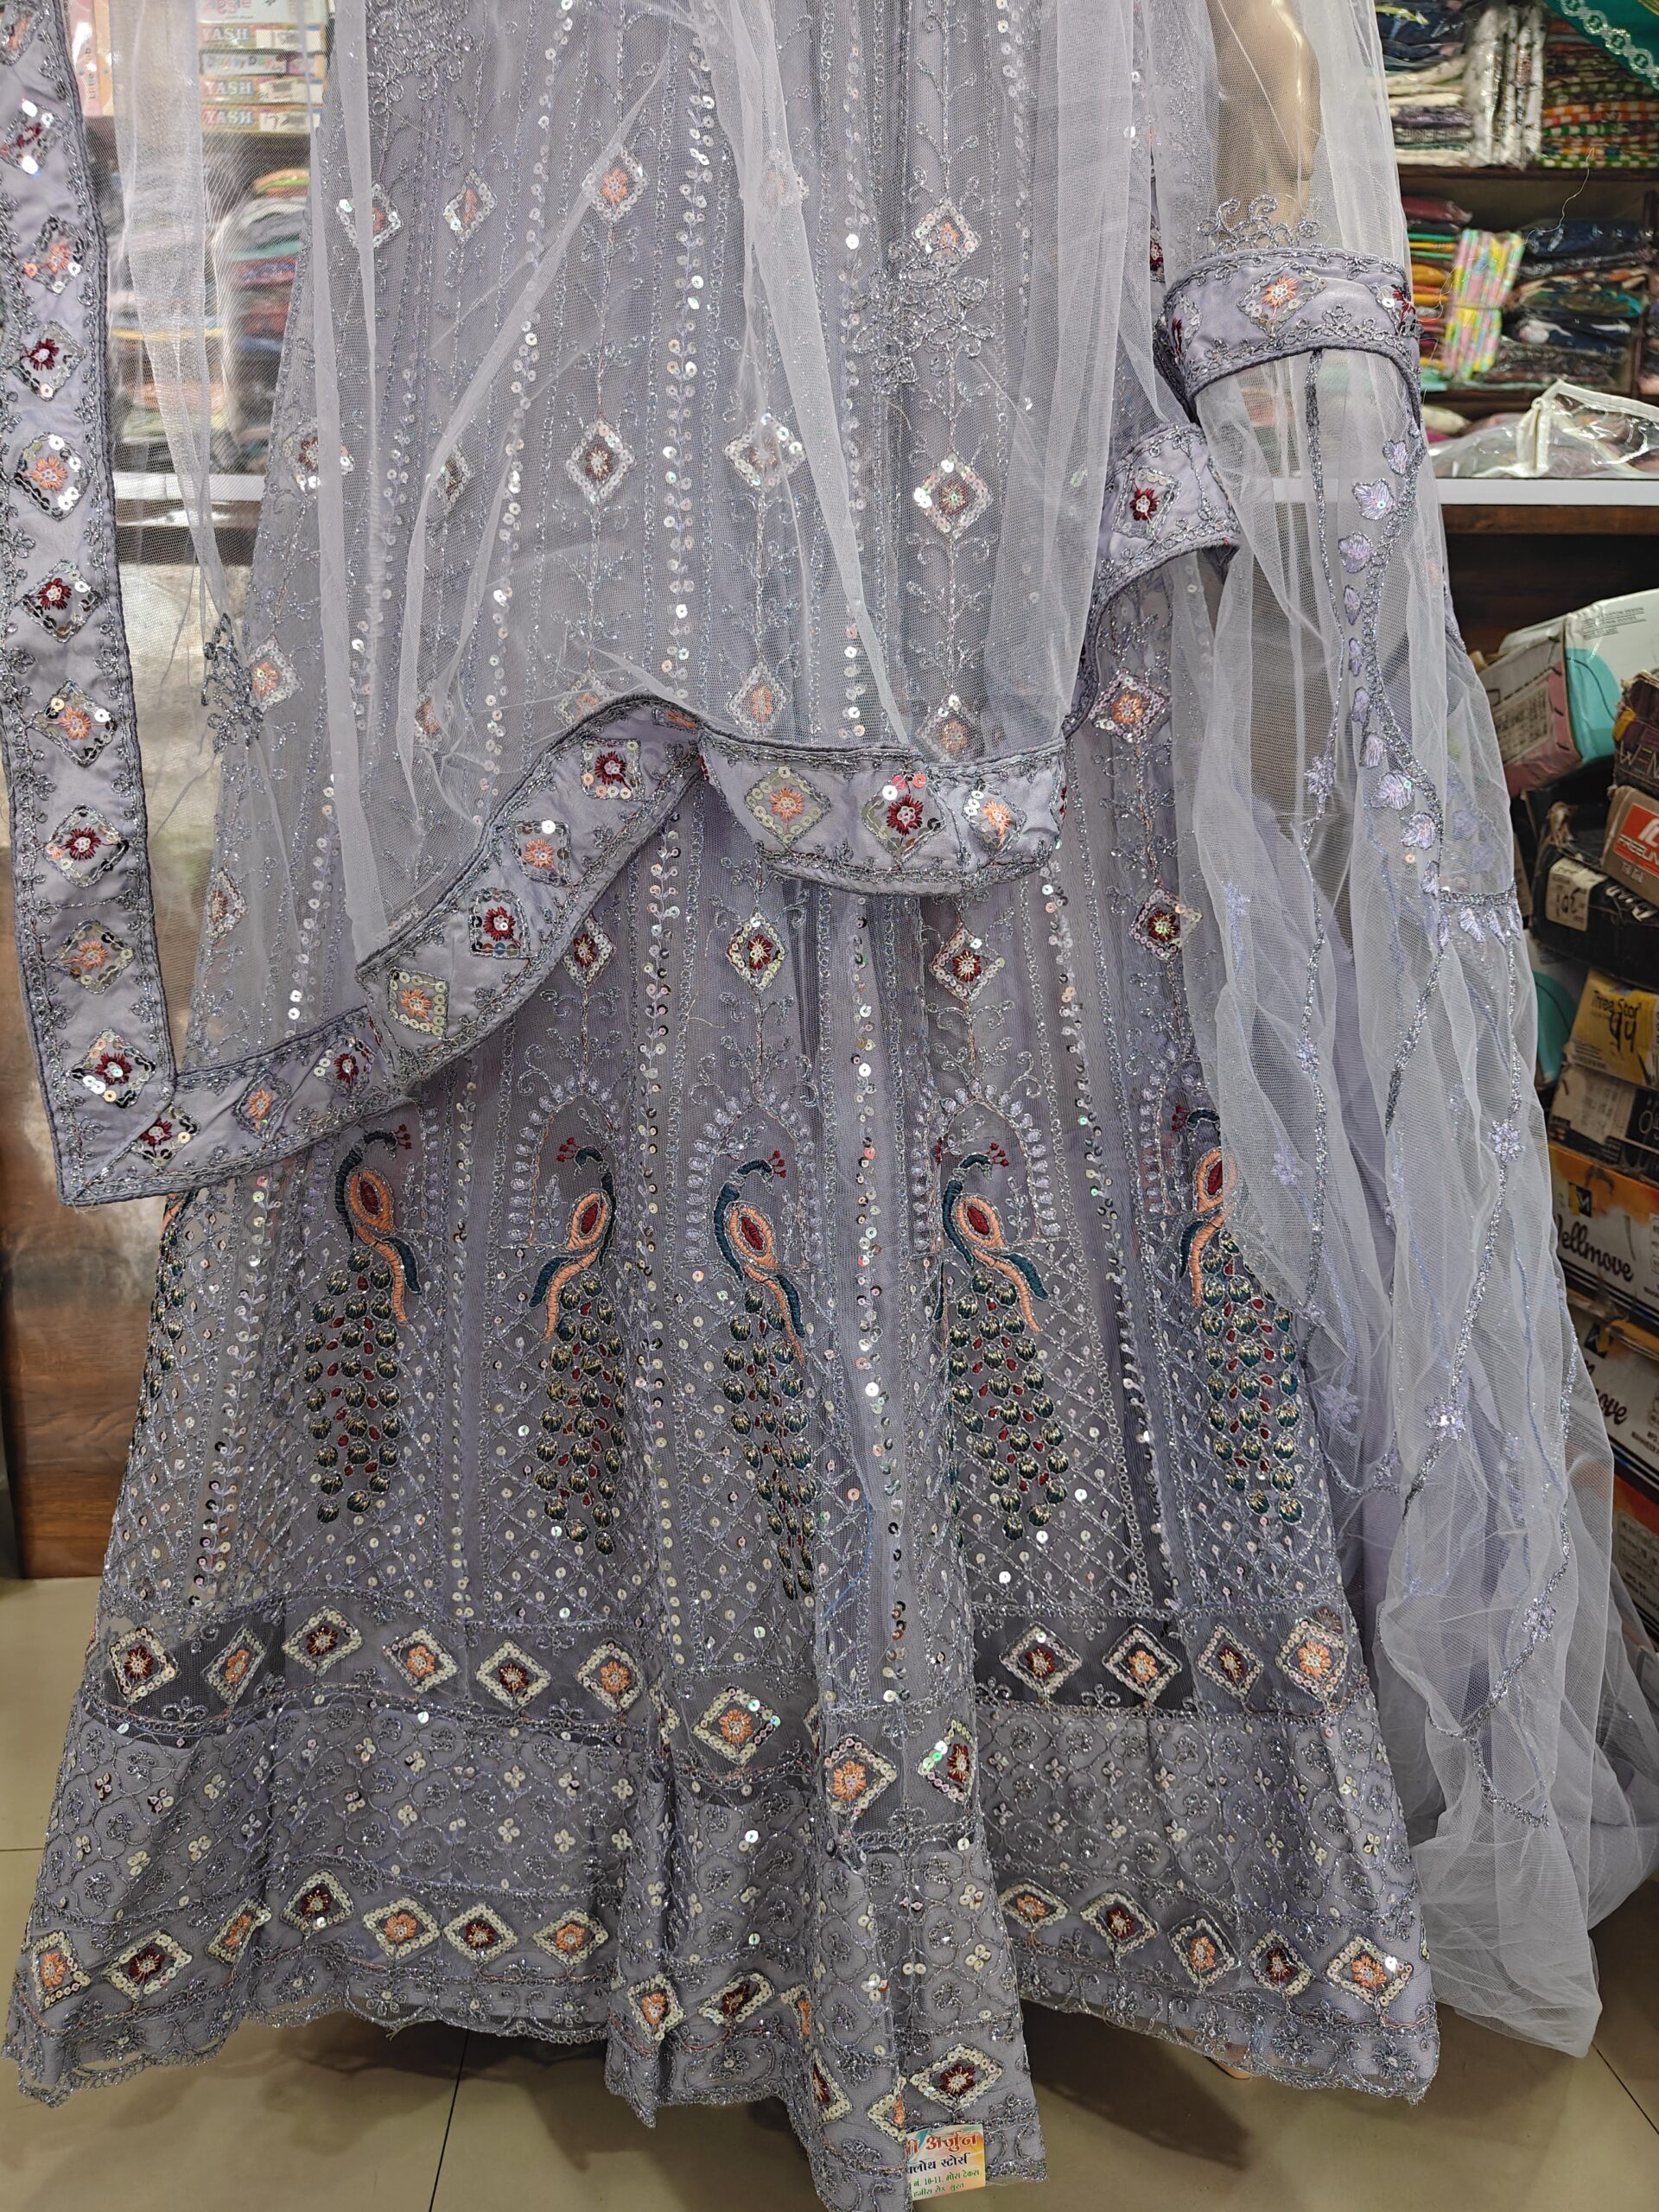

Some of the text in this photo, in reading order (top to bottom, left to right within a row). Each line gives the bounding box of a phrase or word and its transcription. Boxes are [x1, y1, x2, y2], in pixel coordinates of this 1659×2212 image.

[203, 28, 248, 41] YASH
[205, 80, 252, 96] YASH
[204, 110, 252, 124] YASH
